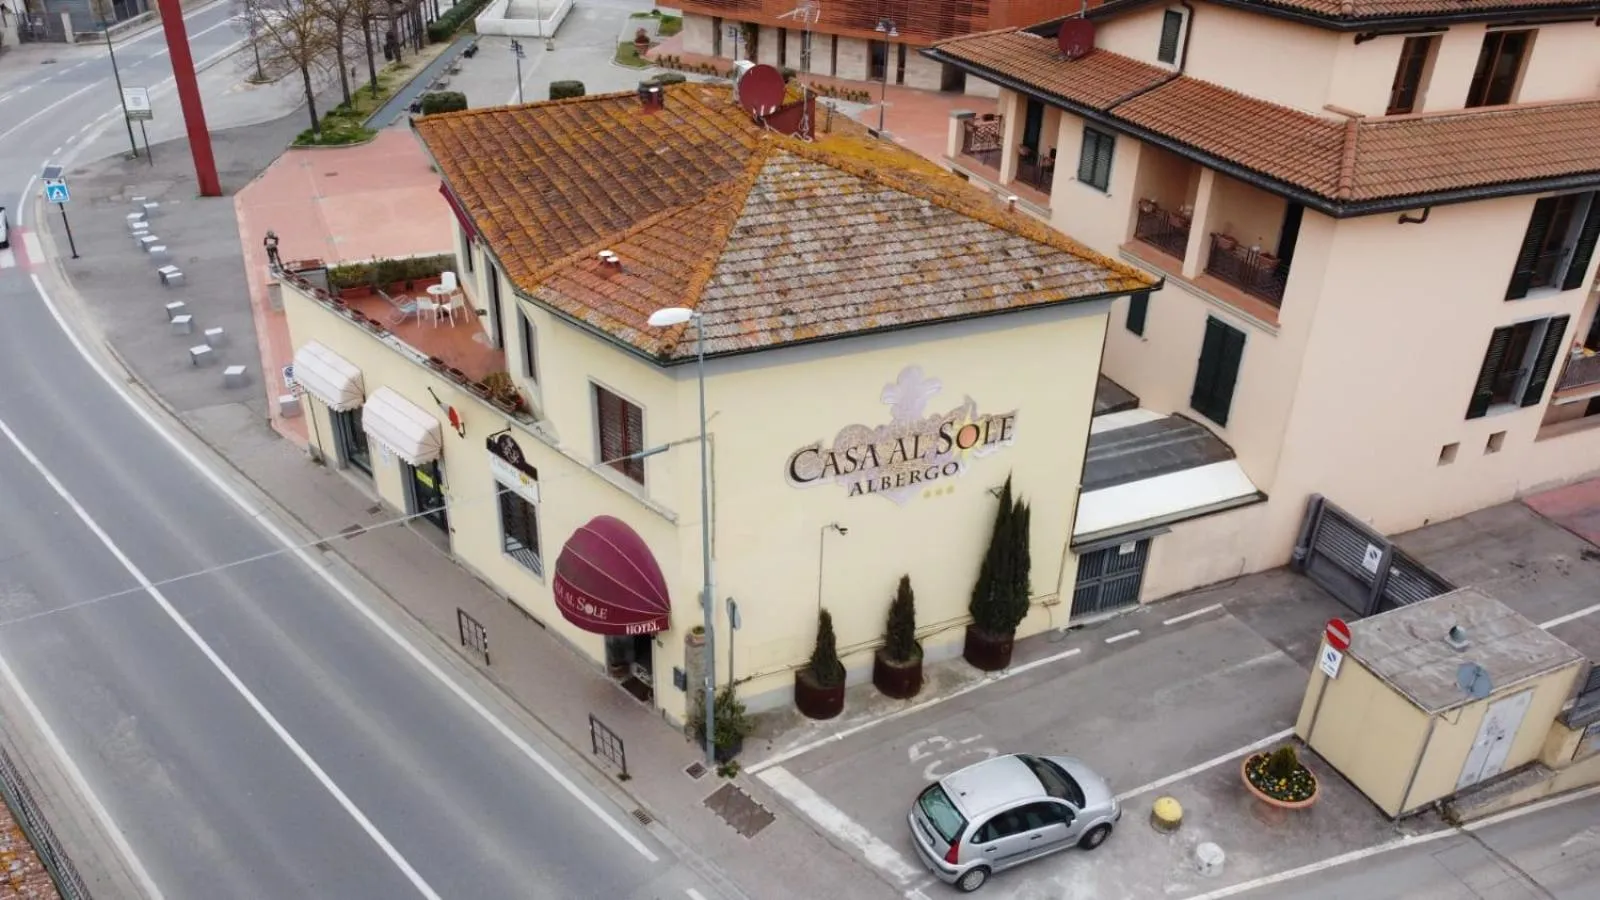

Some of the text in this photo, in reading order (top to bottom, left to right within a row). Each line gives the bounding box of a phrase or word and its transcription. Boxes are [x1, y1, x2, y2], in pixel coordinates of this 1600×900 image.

[789, 415, 1015, 483] CASA AL SOLE
[849, 461, 959, 497] ALBERGO
[576, 597, 608, 620] SOLE
[625, 620, 660, 635] HOTEL
